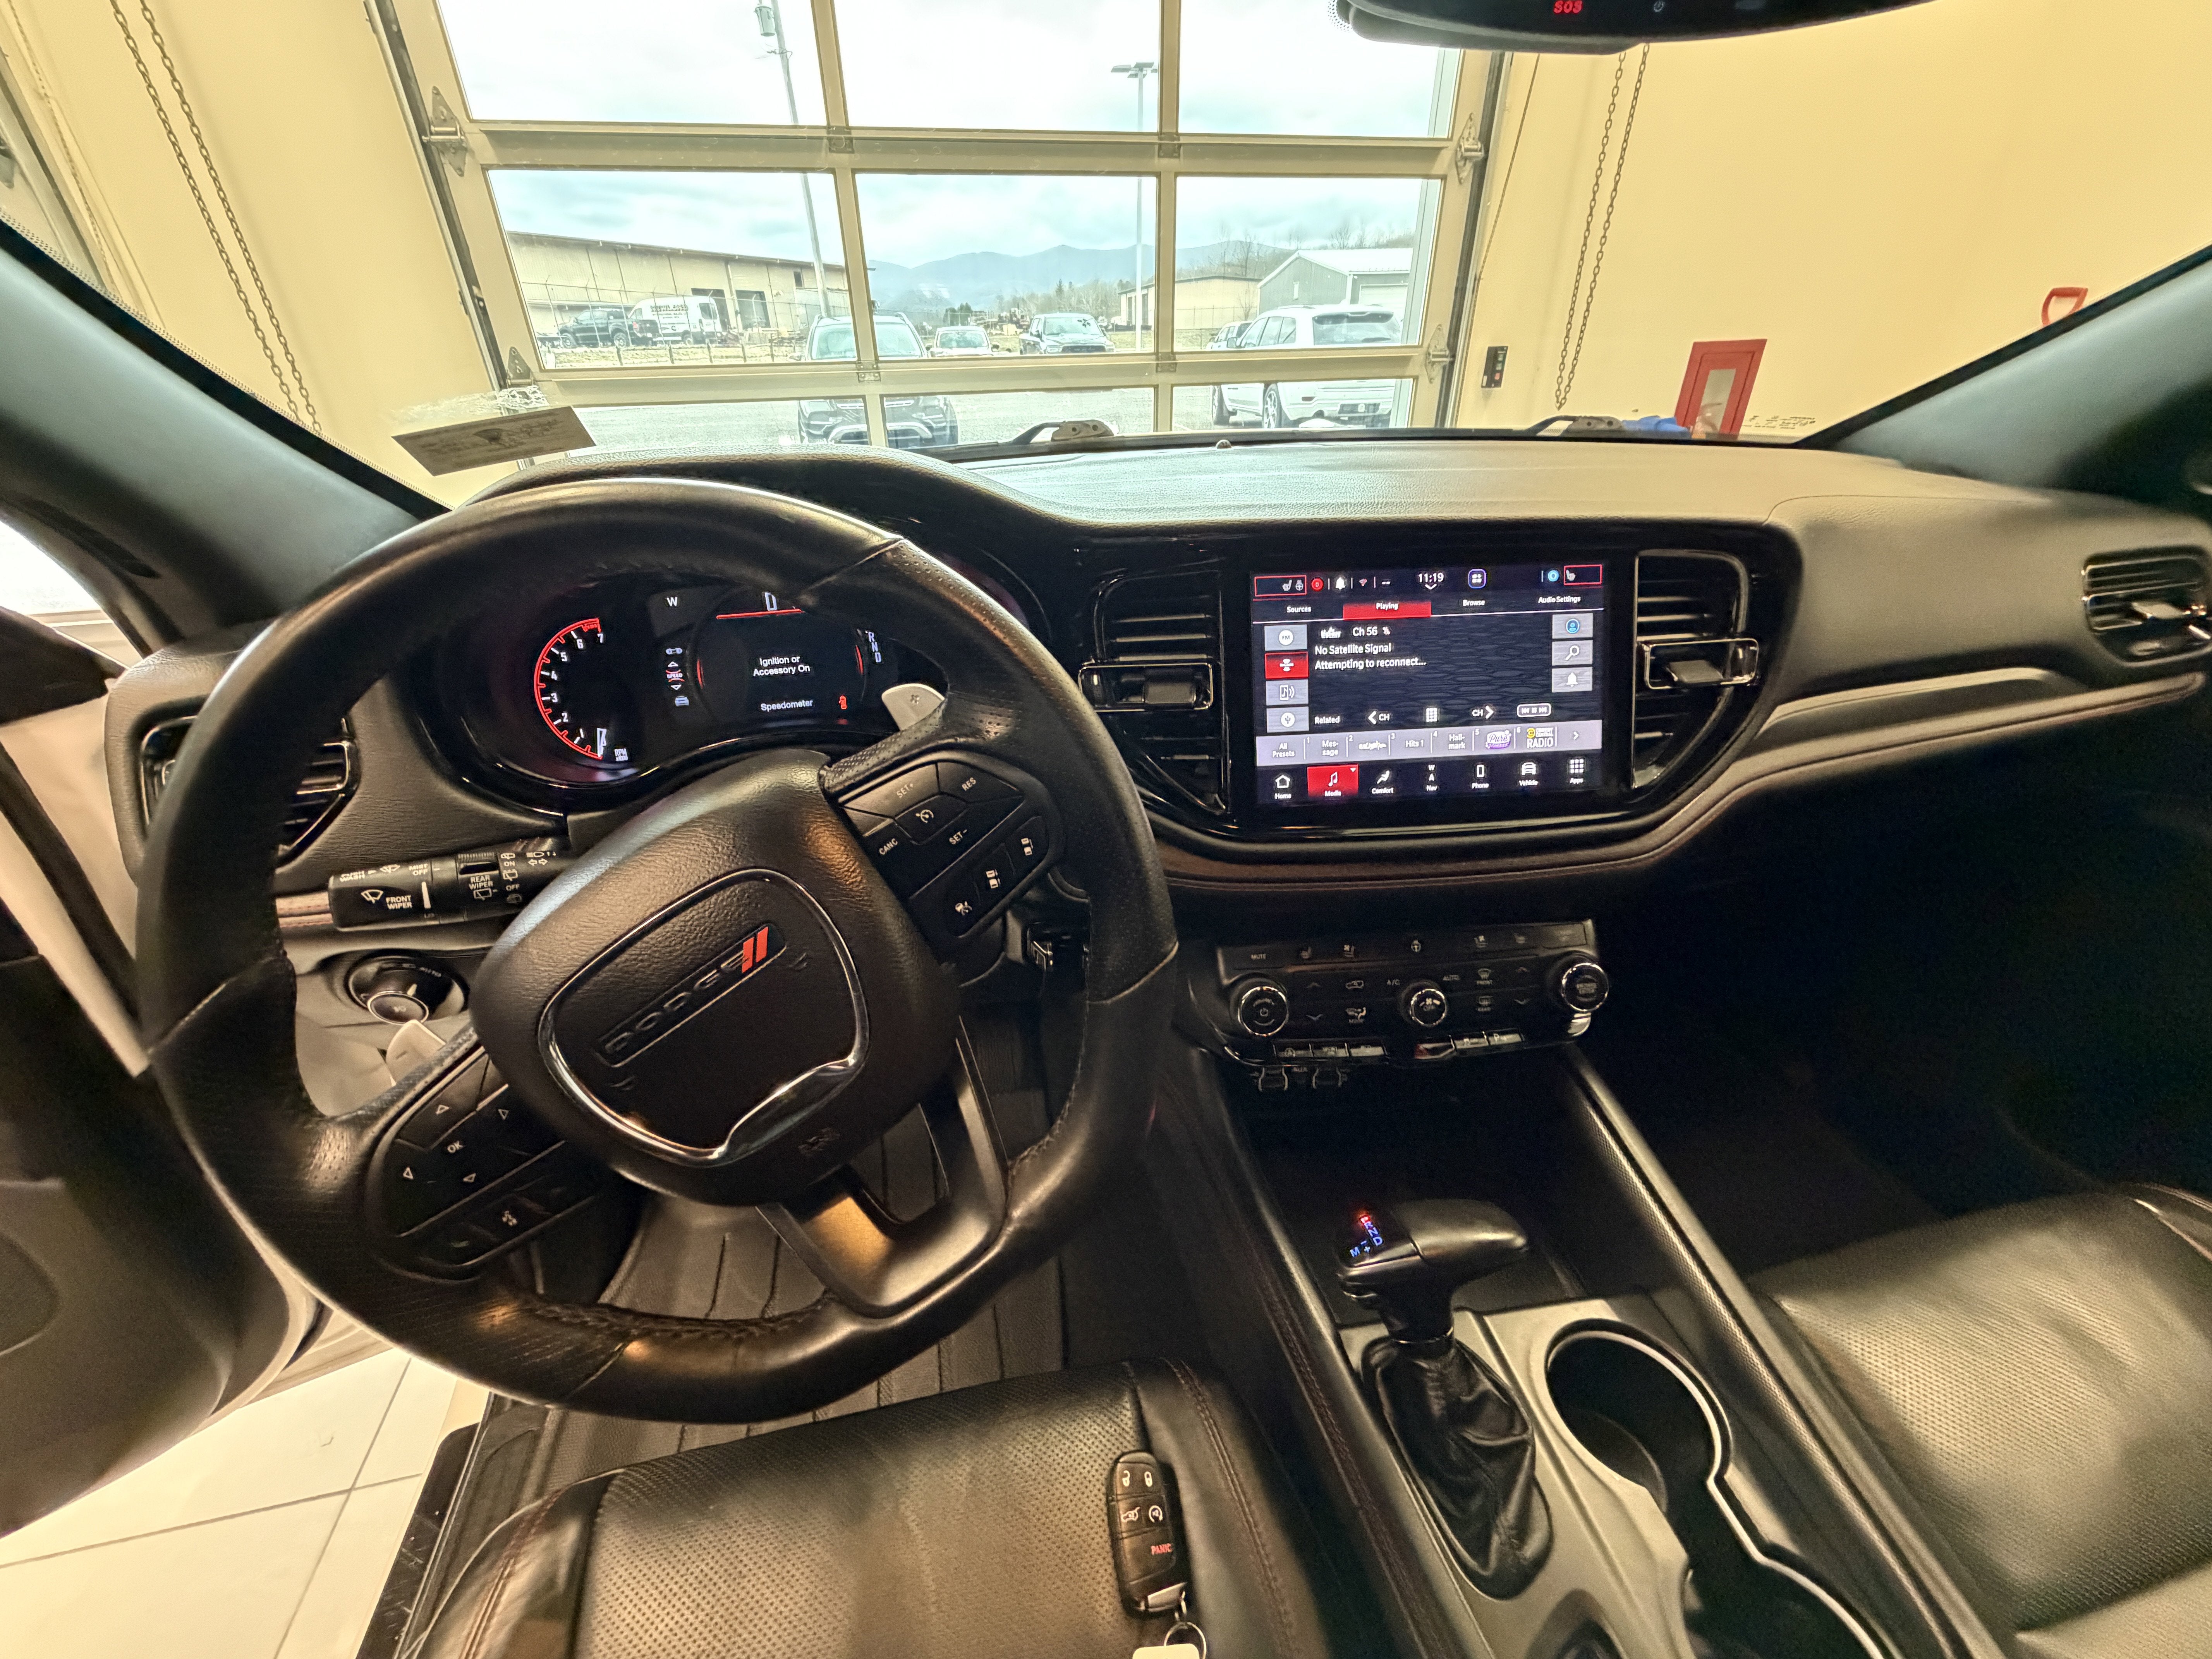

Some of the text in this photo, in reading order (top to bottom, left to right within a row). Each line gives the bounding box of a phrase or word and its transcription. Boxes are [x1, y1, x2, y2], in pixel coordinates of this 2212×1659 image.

[1554, 0, 1582, 14] SOS
[1418, 573, 1444, 583] 11:19
[666, 597, 677, 606] W
[1352, 627, 1378, 636] Ch 56
[597, 633, 603, 643] 7
[576, 639, 584, 649] 6
[1315, 643, 1391, 654] No Satellite Signal
[560, 652, 567, 662] 5
[759, 656, 790, 667] Ignition
[1315, 661, 1365, 672] Attempting
[1376, 657, 1427, 667] reconnect...
[551, 671, 558, 680] 4
[753, 664, 811, 677] Accessory On
[551, 693, 558, 702] 3
[761, 699, 813, 712] Speedometer
[562, 713, 568, 722] 2
[1489, 734, 1508, 742] Pure
[1527, 737, 1554, 748] RADIO
[961, 777, 977, 791] RES
[879, 838, 898, 855] CANC
[470, 874, 490, 883] REAR
[469, 881, 493, 890] WIPER
[386, 895, 412, 903] FRONT
[387, 902, 412, 910] WIPER
[447, 1140, 463, 1152] OK
[1350, 1247, 1360, 1257] M
[1151, 1543, 1172, 1555] PANIC
